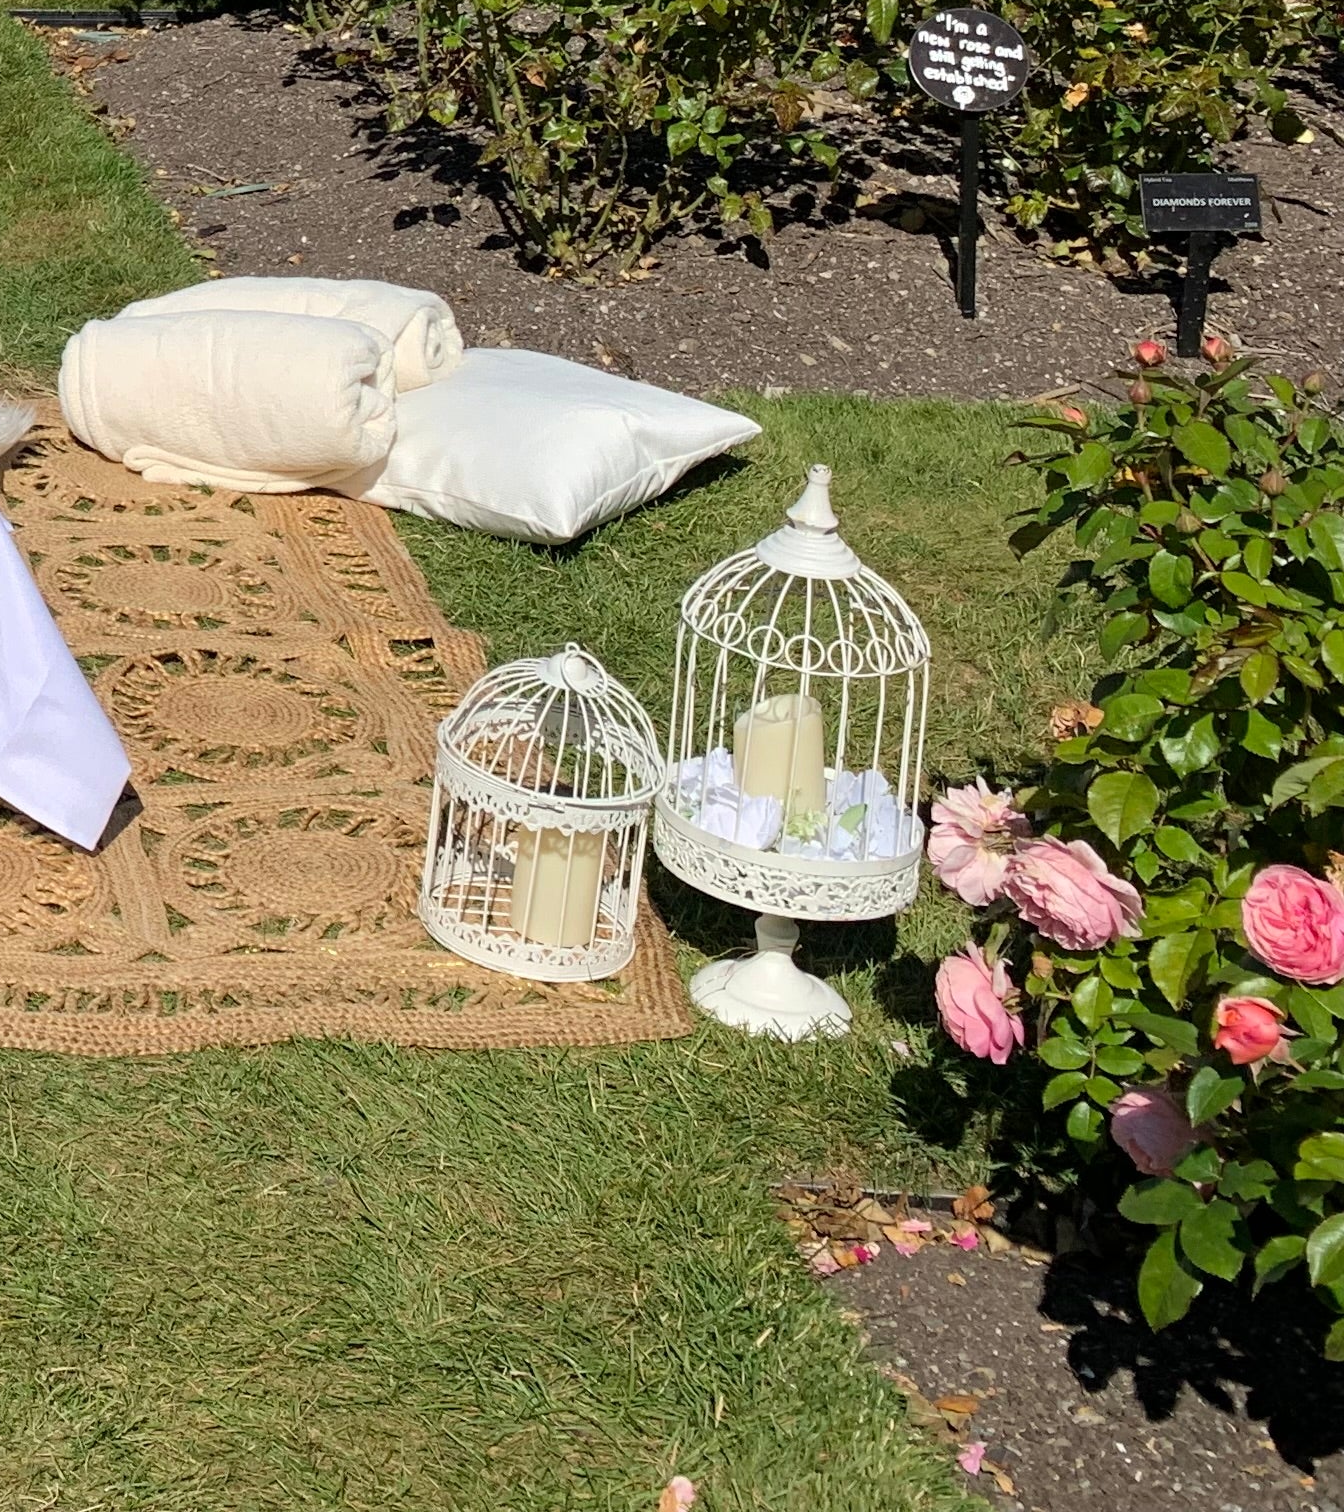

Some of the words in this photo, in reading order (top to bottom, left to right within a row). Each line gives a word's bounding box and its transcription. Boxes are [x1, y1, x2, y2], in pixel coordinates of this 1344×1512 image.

[975, 23, 988, 37] a
[958, 39, 991, 55] rose
[994, 44, 1023, 61] and
[928, 49, 956, 66] still
[960, 55, 1006, 78] getting
[1152, 197, 1207, 207] DIAMONDS
[1208, 197, 1252, 207] FOREVER
